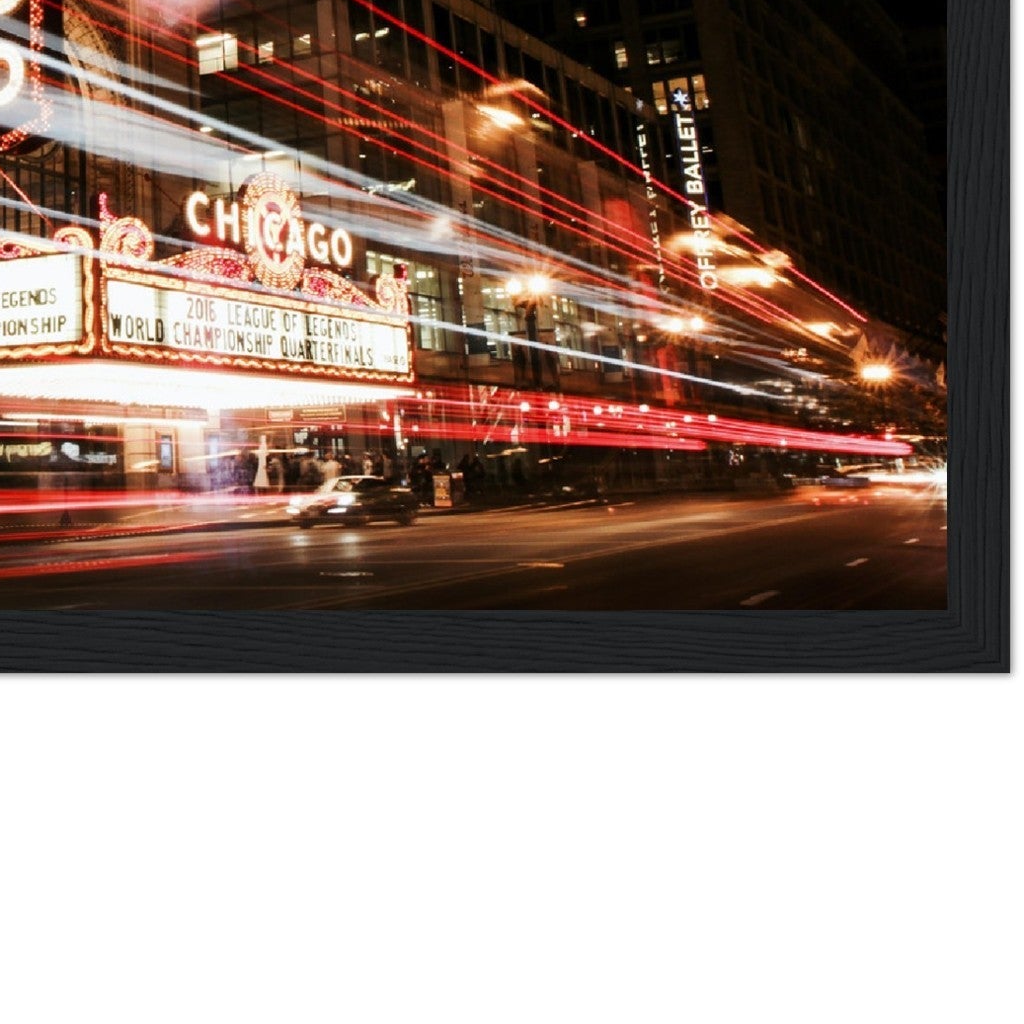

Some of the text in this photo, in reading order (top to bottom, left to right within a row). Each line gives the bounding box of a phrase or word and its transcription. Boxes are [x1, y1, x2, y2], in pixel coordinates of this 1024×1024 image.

[677, 113, 704, 194] BALLET
[186, 191, 353, 267] CHICAGO
[110, 313, 374, 366] WORLD CHAMPIONSHIP QUARTERFINALS
[186, 297, 357, 342] 2016 LEAGUE OF LEGENDS
